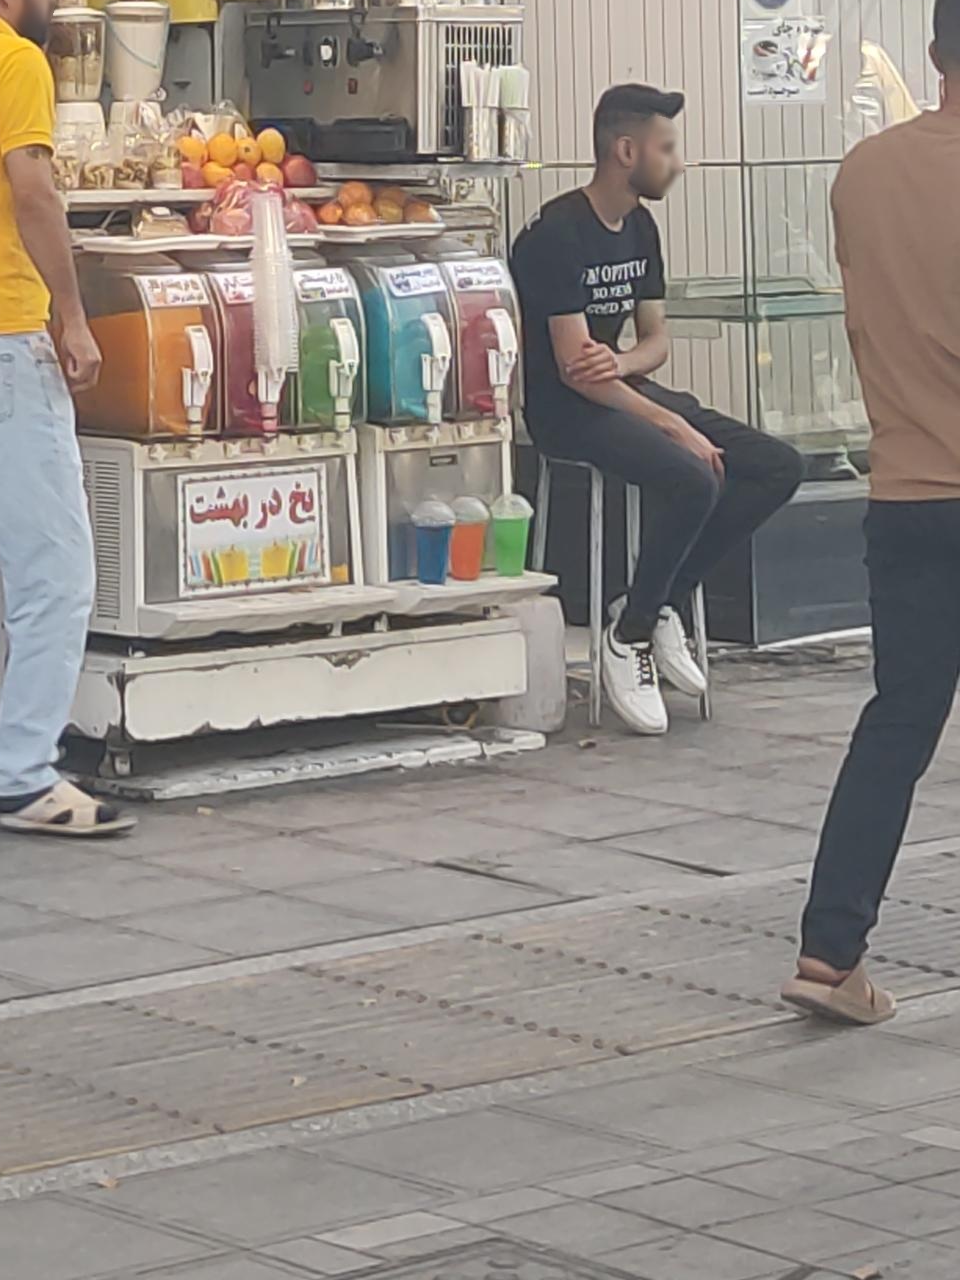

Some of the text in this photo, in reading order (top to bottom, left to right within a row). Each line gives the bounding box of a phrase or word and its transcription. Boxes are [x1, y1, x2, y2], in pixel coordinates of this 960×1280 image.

[190, 481, 316, 529] یخ در بهشت
